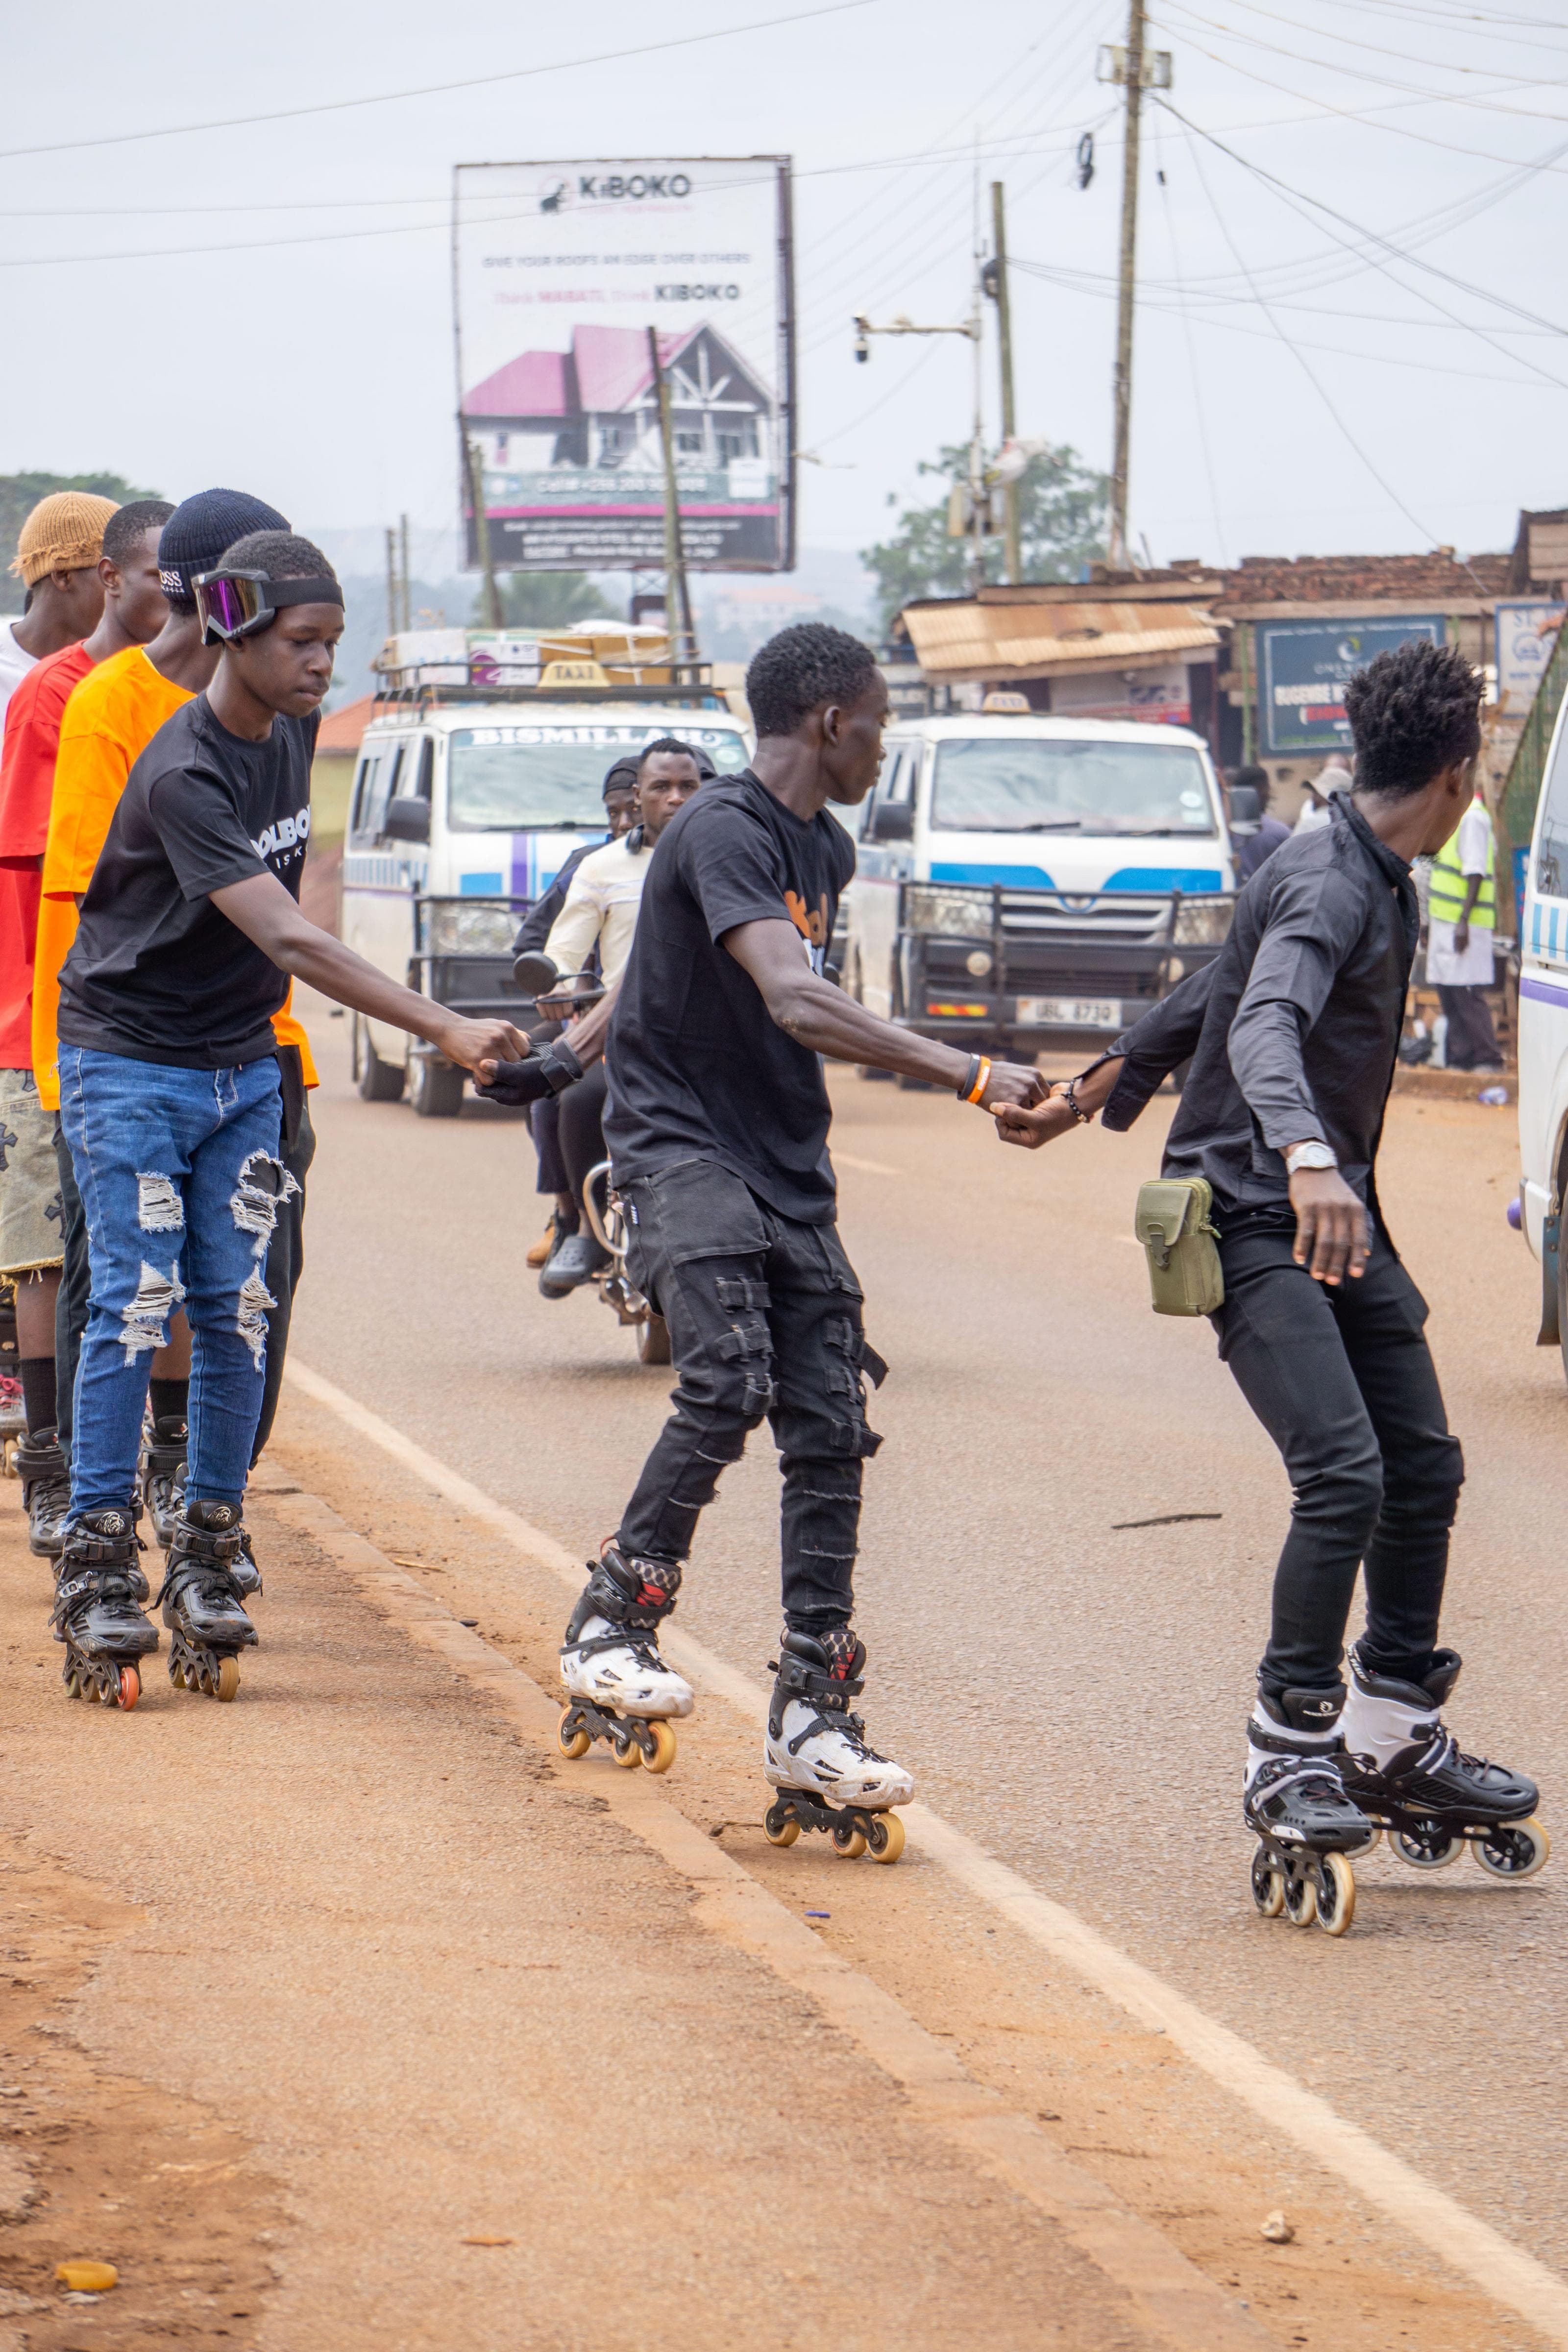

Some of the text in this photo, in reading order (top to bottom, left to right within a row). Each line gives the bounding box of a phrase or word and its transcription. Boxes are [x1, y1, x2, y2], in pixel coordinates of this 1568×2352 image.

[700, 253, 751, 264] OTHERS
[554, 665, 594, 680] TAXI
[250, 805, 311, 859] OLBO
